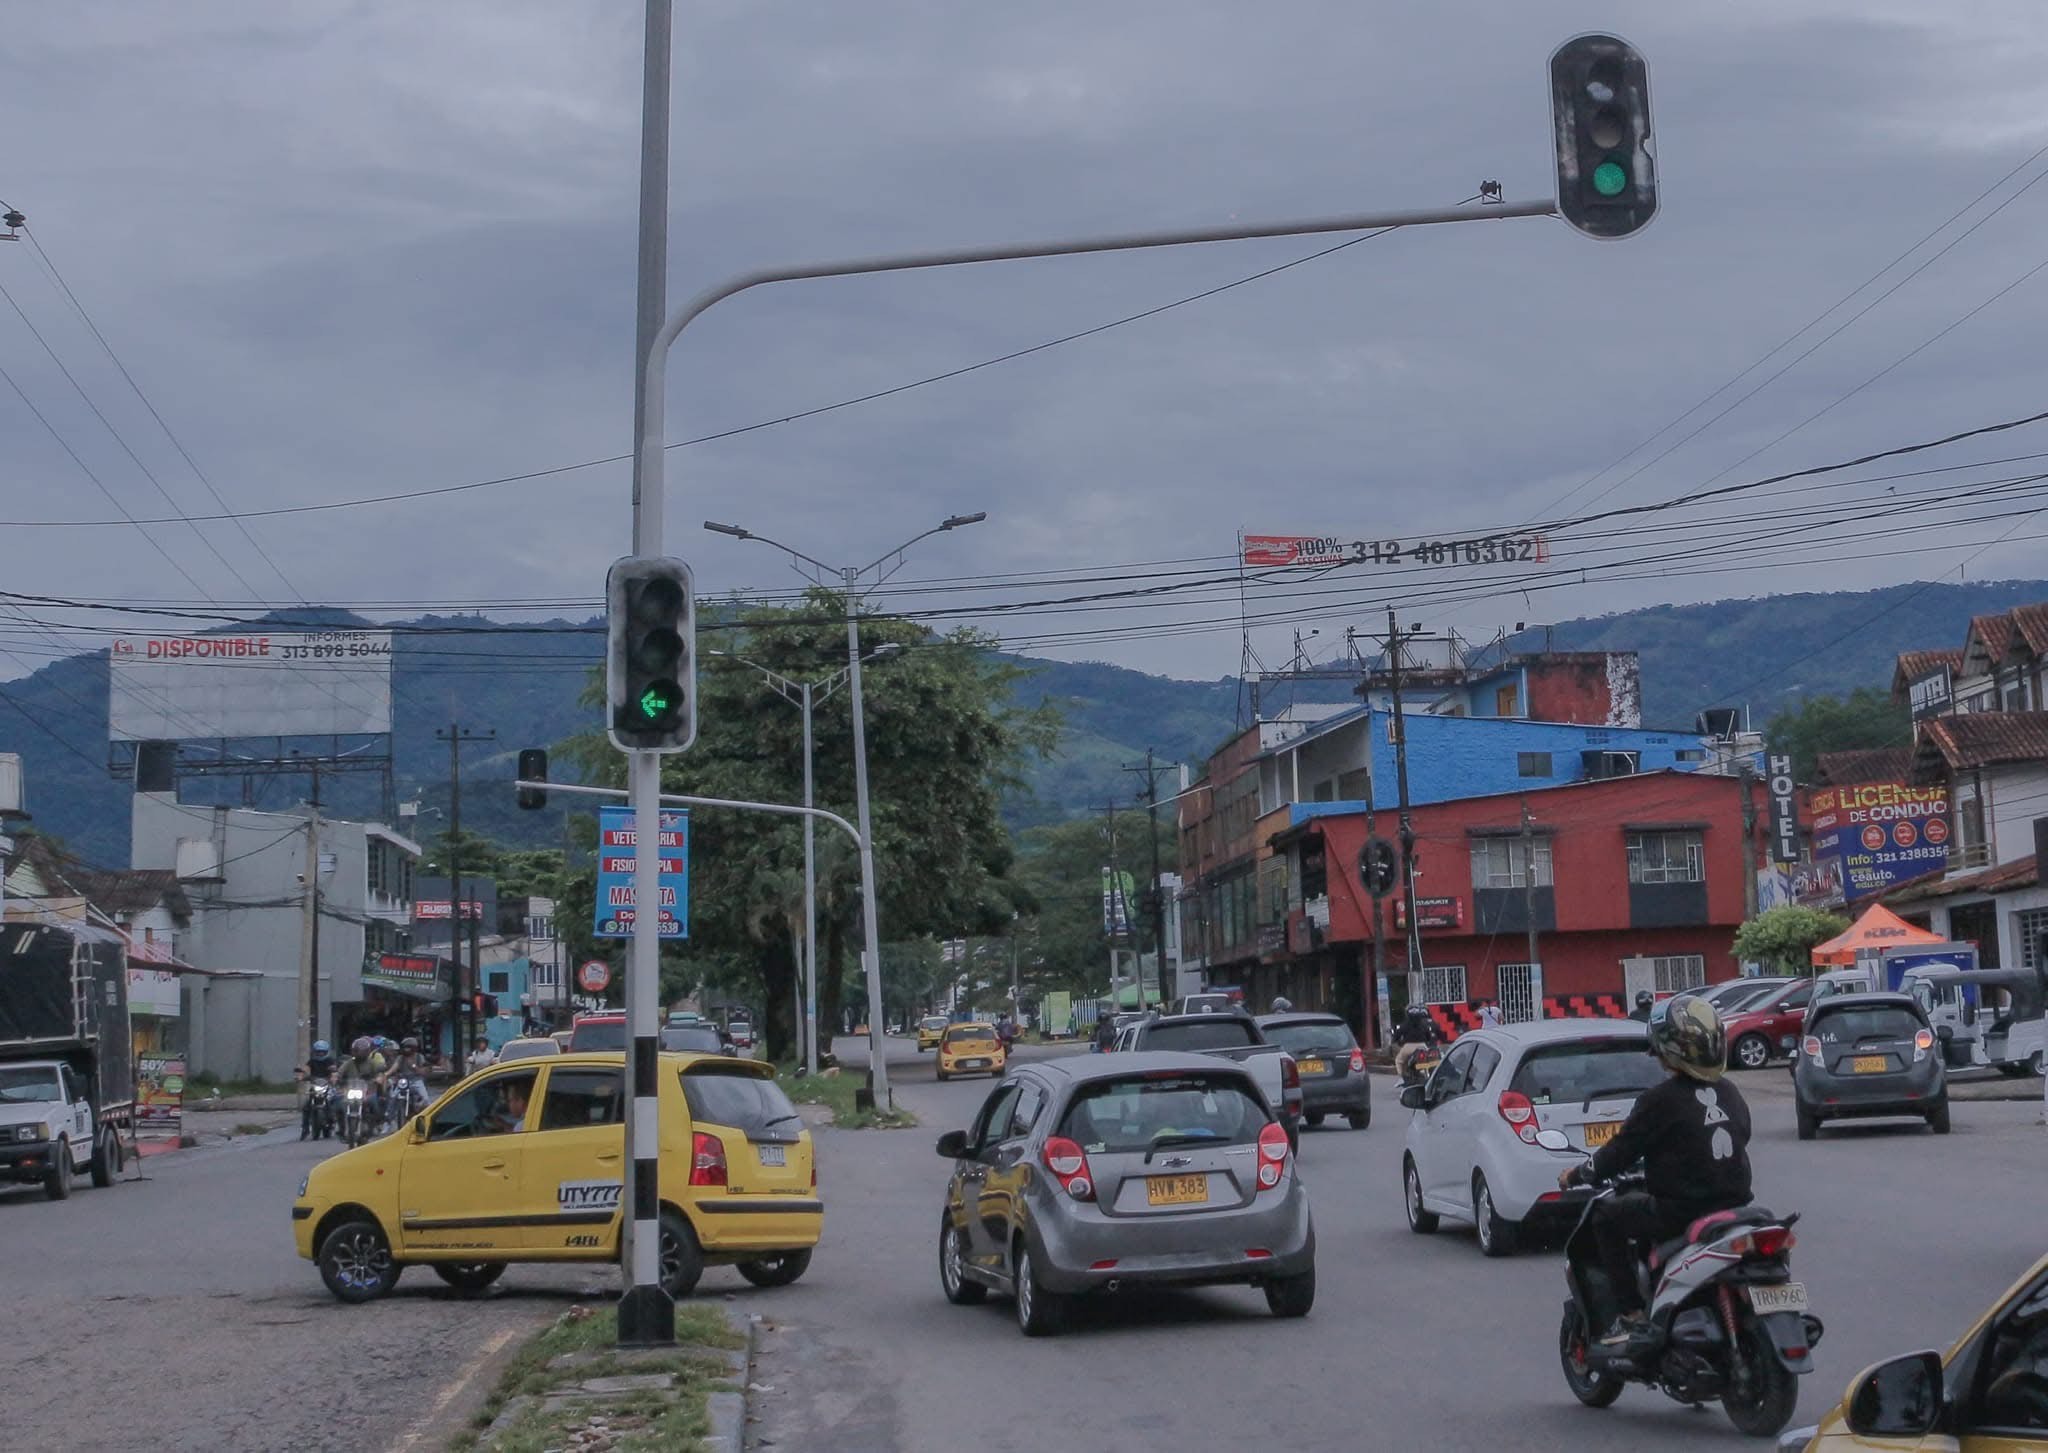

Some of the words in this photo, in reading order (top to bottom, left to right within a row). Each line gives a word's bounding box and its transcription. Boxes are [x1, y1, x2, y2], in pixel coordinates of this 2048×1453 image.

[1296, 537, 1343, 556] 100%
[1351, 541, 1400, 564] 312
[1415, 539, 1533, 564] 4816362
[147, 637, 270, 659] DISPONIBLE
[282, 645, 309, 660] 313
[314, 643, 344, 659] 898
[349, 641, 391, 657] 5044
[1770, 755, 1796, 858] HOTEL
[1849, 810, 1867, 823] DE
[1870, 800, 1947, 820] CONDUC
[612, 831, 678, 846] VETERIA
[611, 859, 673, 873] FISIOPIA
[1847, 854, 1874, 866] Info:
[1876, 852, 1898, 864] 321
[1851, 869, 1896, 882] ceauto.
[609, 885, 677, 907] MATA
[618, 921, 679, 934] 3145538
[557, 1184, 624, 1203] UTY777
[1150, 1177, 1176, 1197] HVW
[1180, 1176, 1205, 1194] 383
